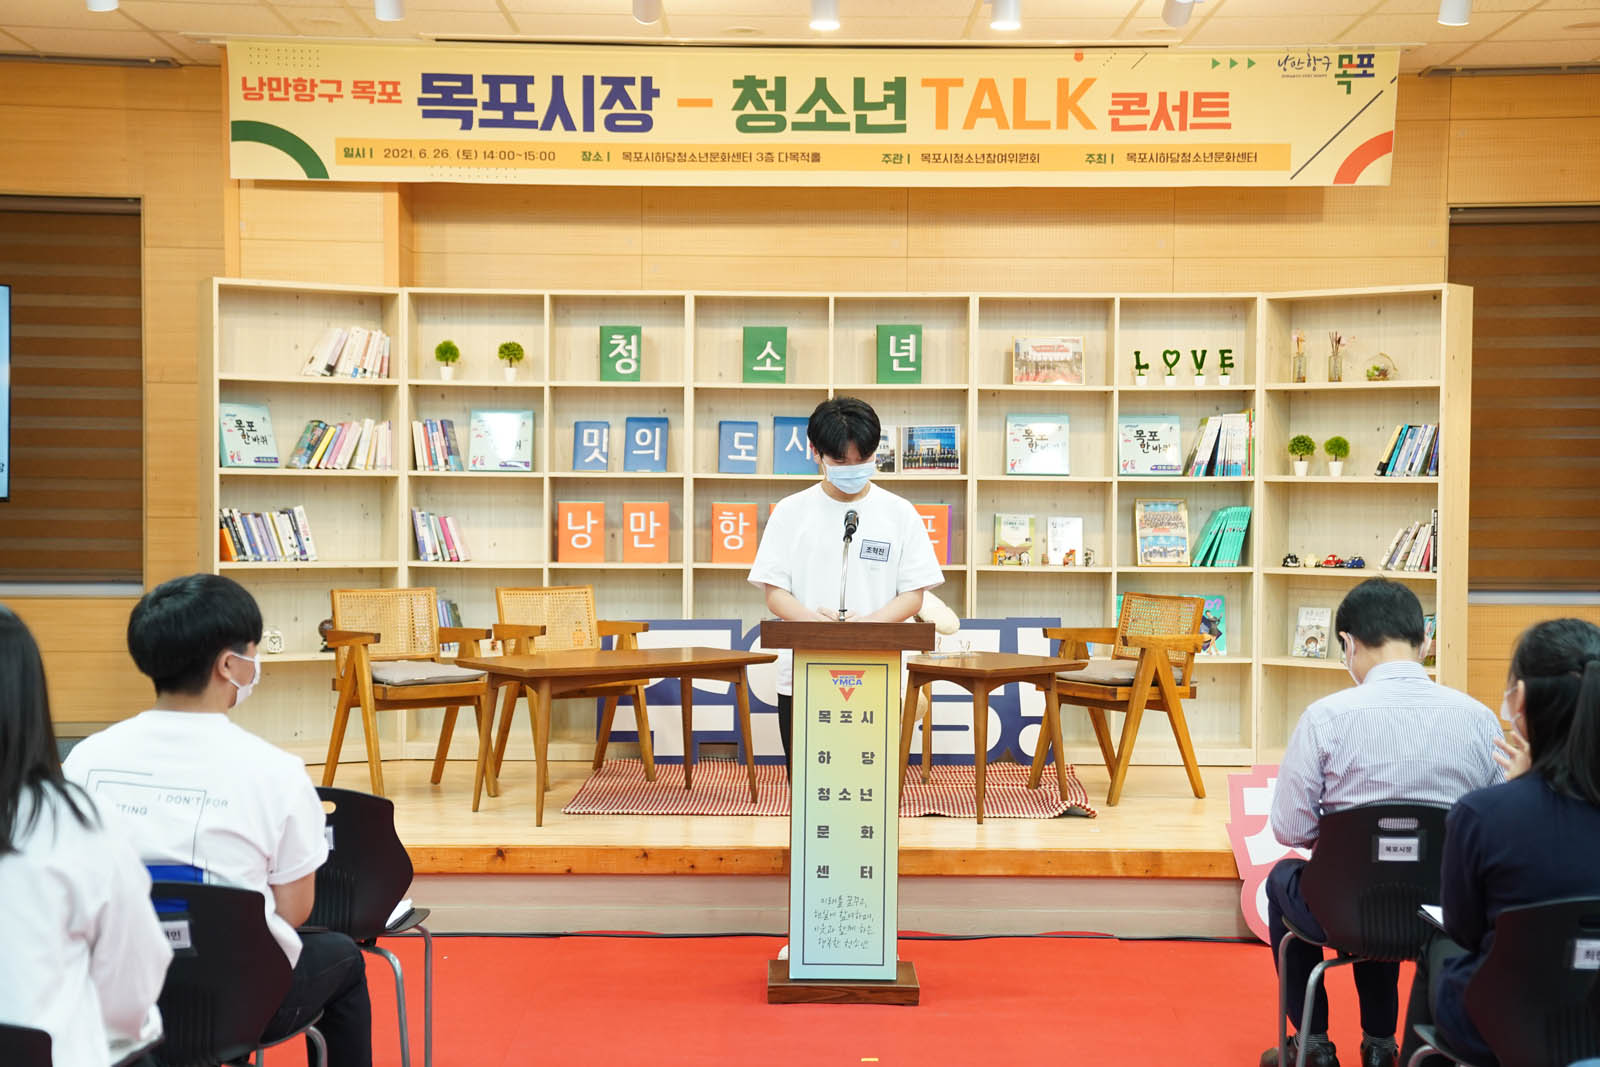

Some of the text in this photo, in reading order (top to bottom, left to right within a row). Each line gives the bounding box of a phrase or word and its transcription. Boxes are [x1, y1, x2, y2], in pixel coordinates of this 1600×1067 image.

[1334, 54, 1375, 95] 목포
[241, 76, 344, 103] 낭만항구
[351, 80, 403, 105] 목포
[416, 73, 660, 133] 목포시장
[731, 75, 907, 134] 청소년
[921, 77, 1098, 131] TALK
[1108, 91, 1232, 133] 콘서트
[343, 147, 366, 159] 일시
[456, 149, 478, 161] (토)
[482, 150, 556, 162] 14:00~15:00
[581, 151, 603, 162] 장소
[622, 151, 752, 163] 목포시하당청소년문화센터
[756, 152, 774, 163] 3층
[881, 152, 1040, 165] 주관 목포시청소년참여위원회
[1085, 151, 1258, 165] 주최 목포시하당청소년문화센터
[608, 334, 917, 374] 청 소 년
[1133, 429, 1160, 443] 목포
[631, 427, 661, 461] 의
[727, 432, 758, 461] 도
[566, 510, 750, 550] 낭 만 항
[832, 678, 863, 687] YMCA
[166, 793, 201, 806] DON'T
